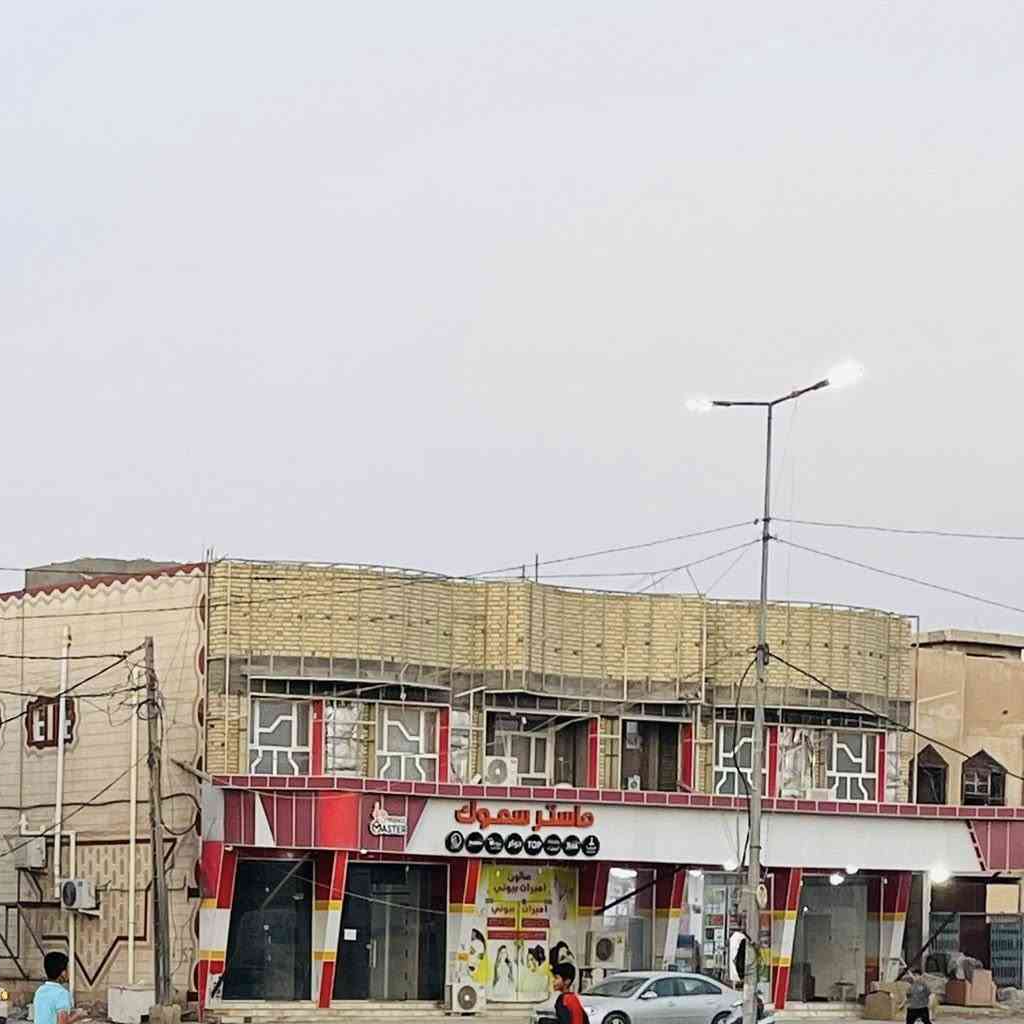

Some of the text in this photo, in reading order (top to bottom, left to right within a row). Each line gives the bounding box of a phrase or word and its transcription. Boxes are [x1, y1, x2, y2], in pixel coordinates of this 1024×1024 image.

[455, 800, 594, 831] ماستر سموك
[527, 840, 542, 849] TOP
